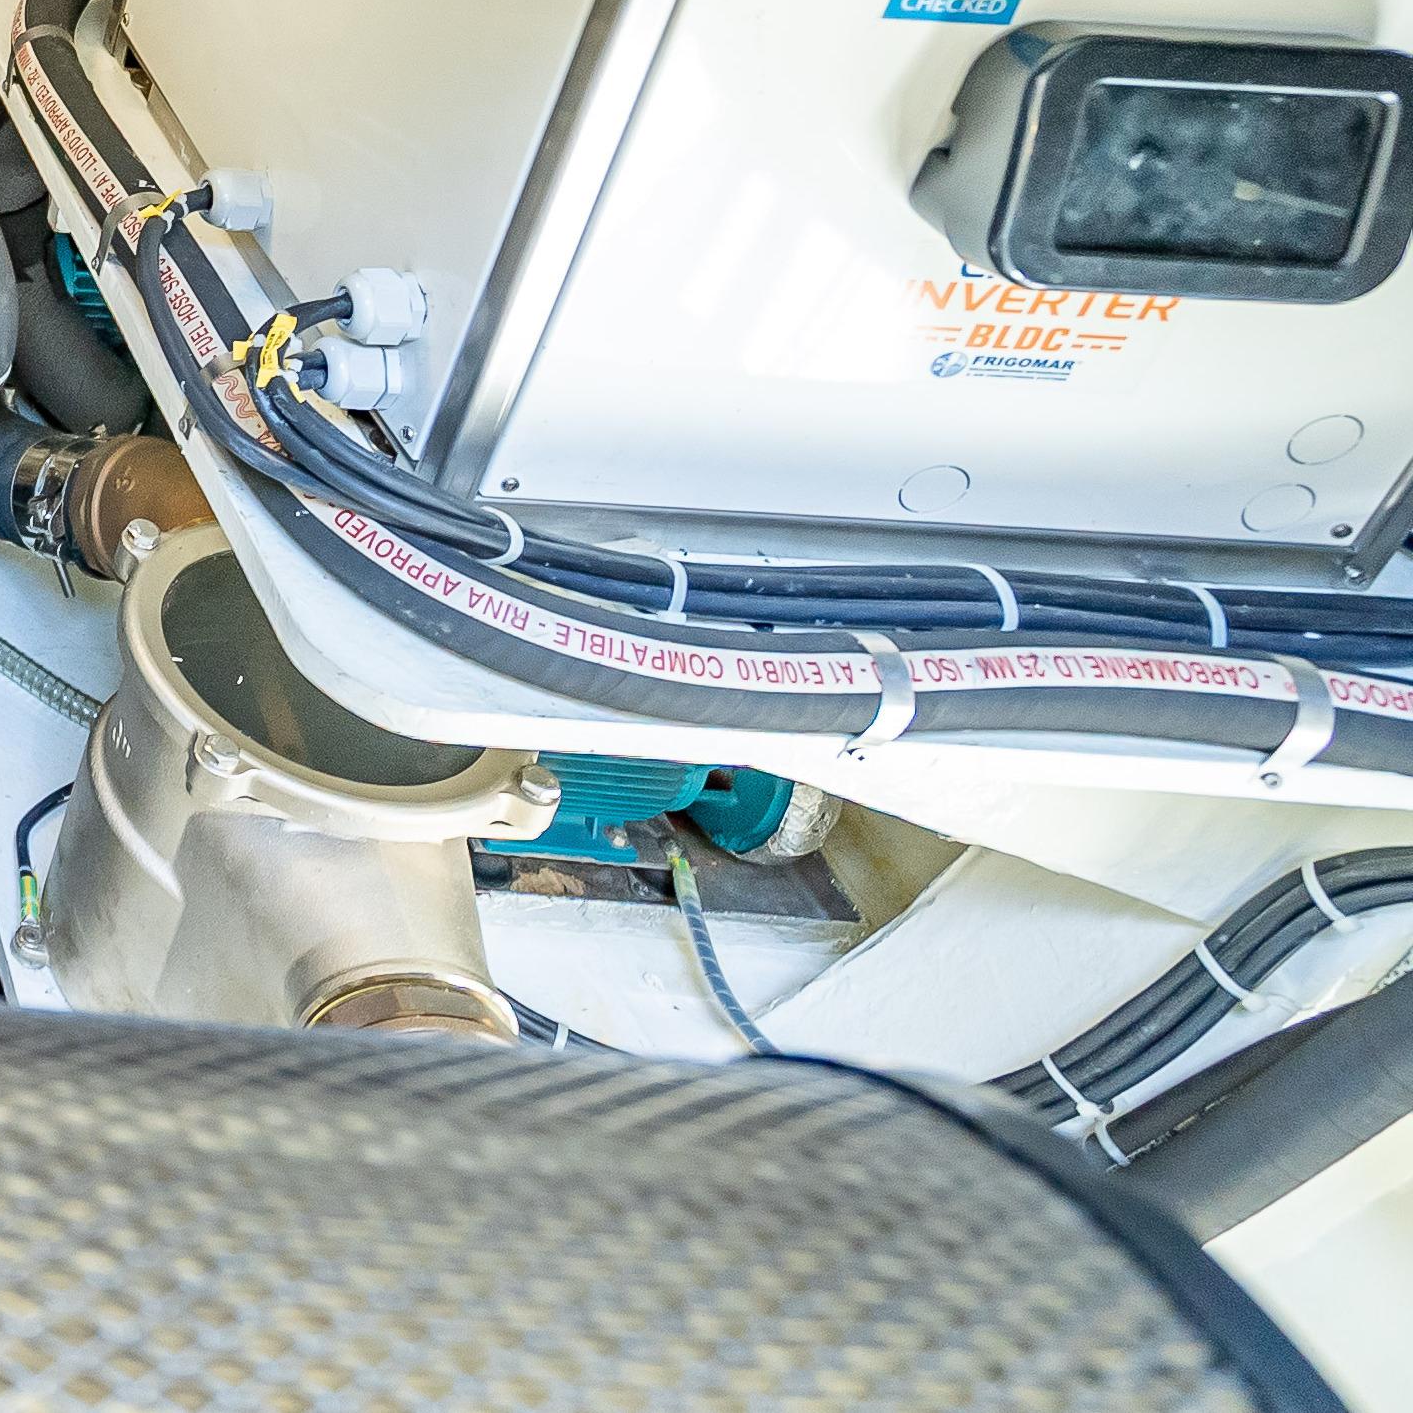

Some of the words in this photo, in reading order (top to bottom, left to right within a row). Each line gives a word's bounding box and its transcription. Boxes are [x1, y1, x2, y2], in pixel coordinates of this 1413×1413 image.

[34, 84, 71, 133] APPROVED
[62, 128, 98, 172] LLOYD'S
[92, 171, 110, 188] A1
[101, 183, 125, 209] YPE
[169, 288, 200, 326] HOSE
[188, 321, 218, 358] FUEL
[965, 324, 1071, 351] BLDC
[971, 355, 1076, 371] FRIGOMAR
[334, 507, 461, 595] APPROVED
[466, 586, 530, 633] RINA
[553, 620, 724, 680] COMPATIBLE
[736, 657, 824, 685] E10/B10
[829, 659, 856, 684] A1
[926, 656, 963, 681] ISO
[983, 656, 1018, 679] MM
[1024, 653, 1045, 678] 25
[1083, 654, 1260, 690] CARBOMARINE
